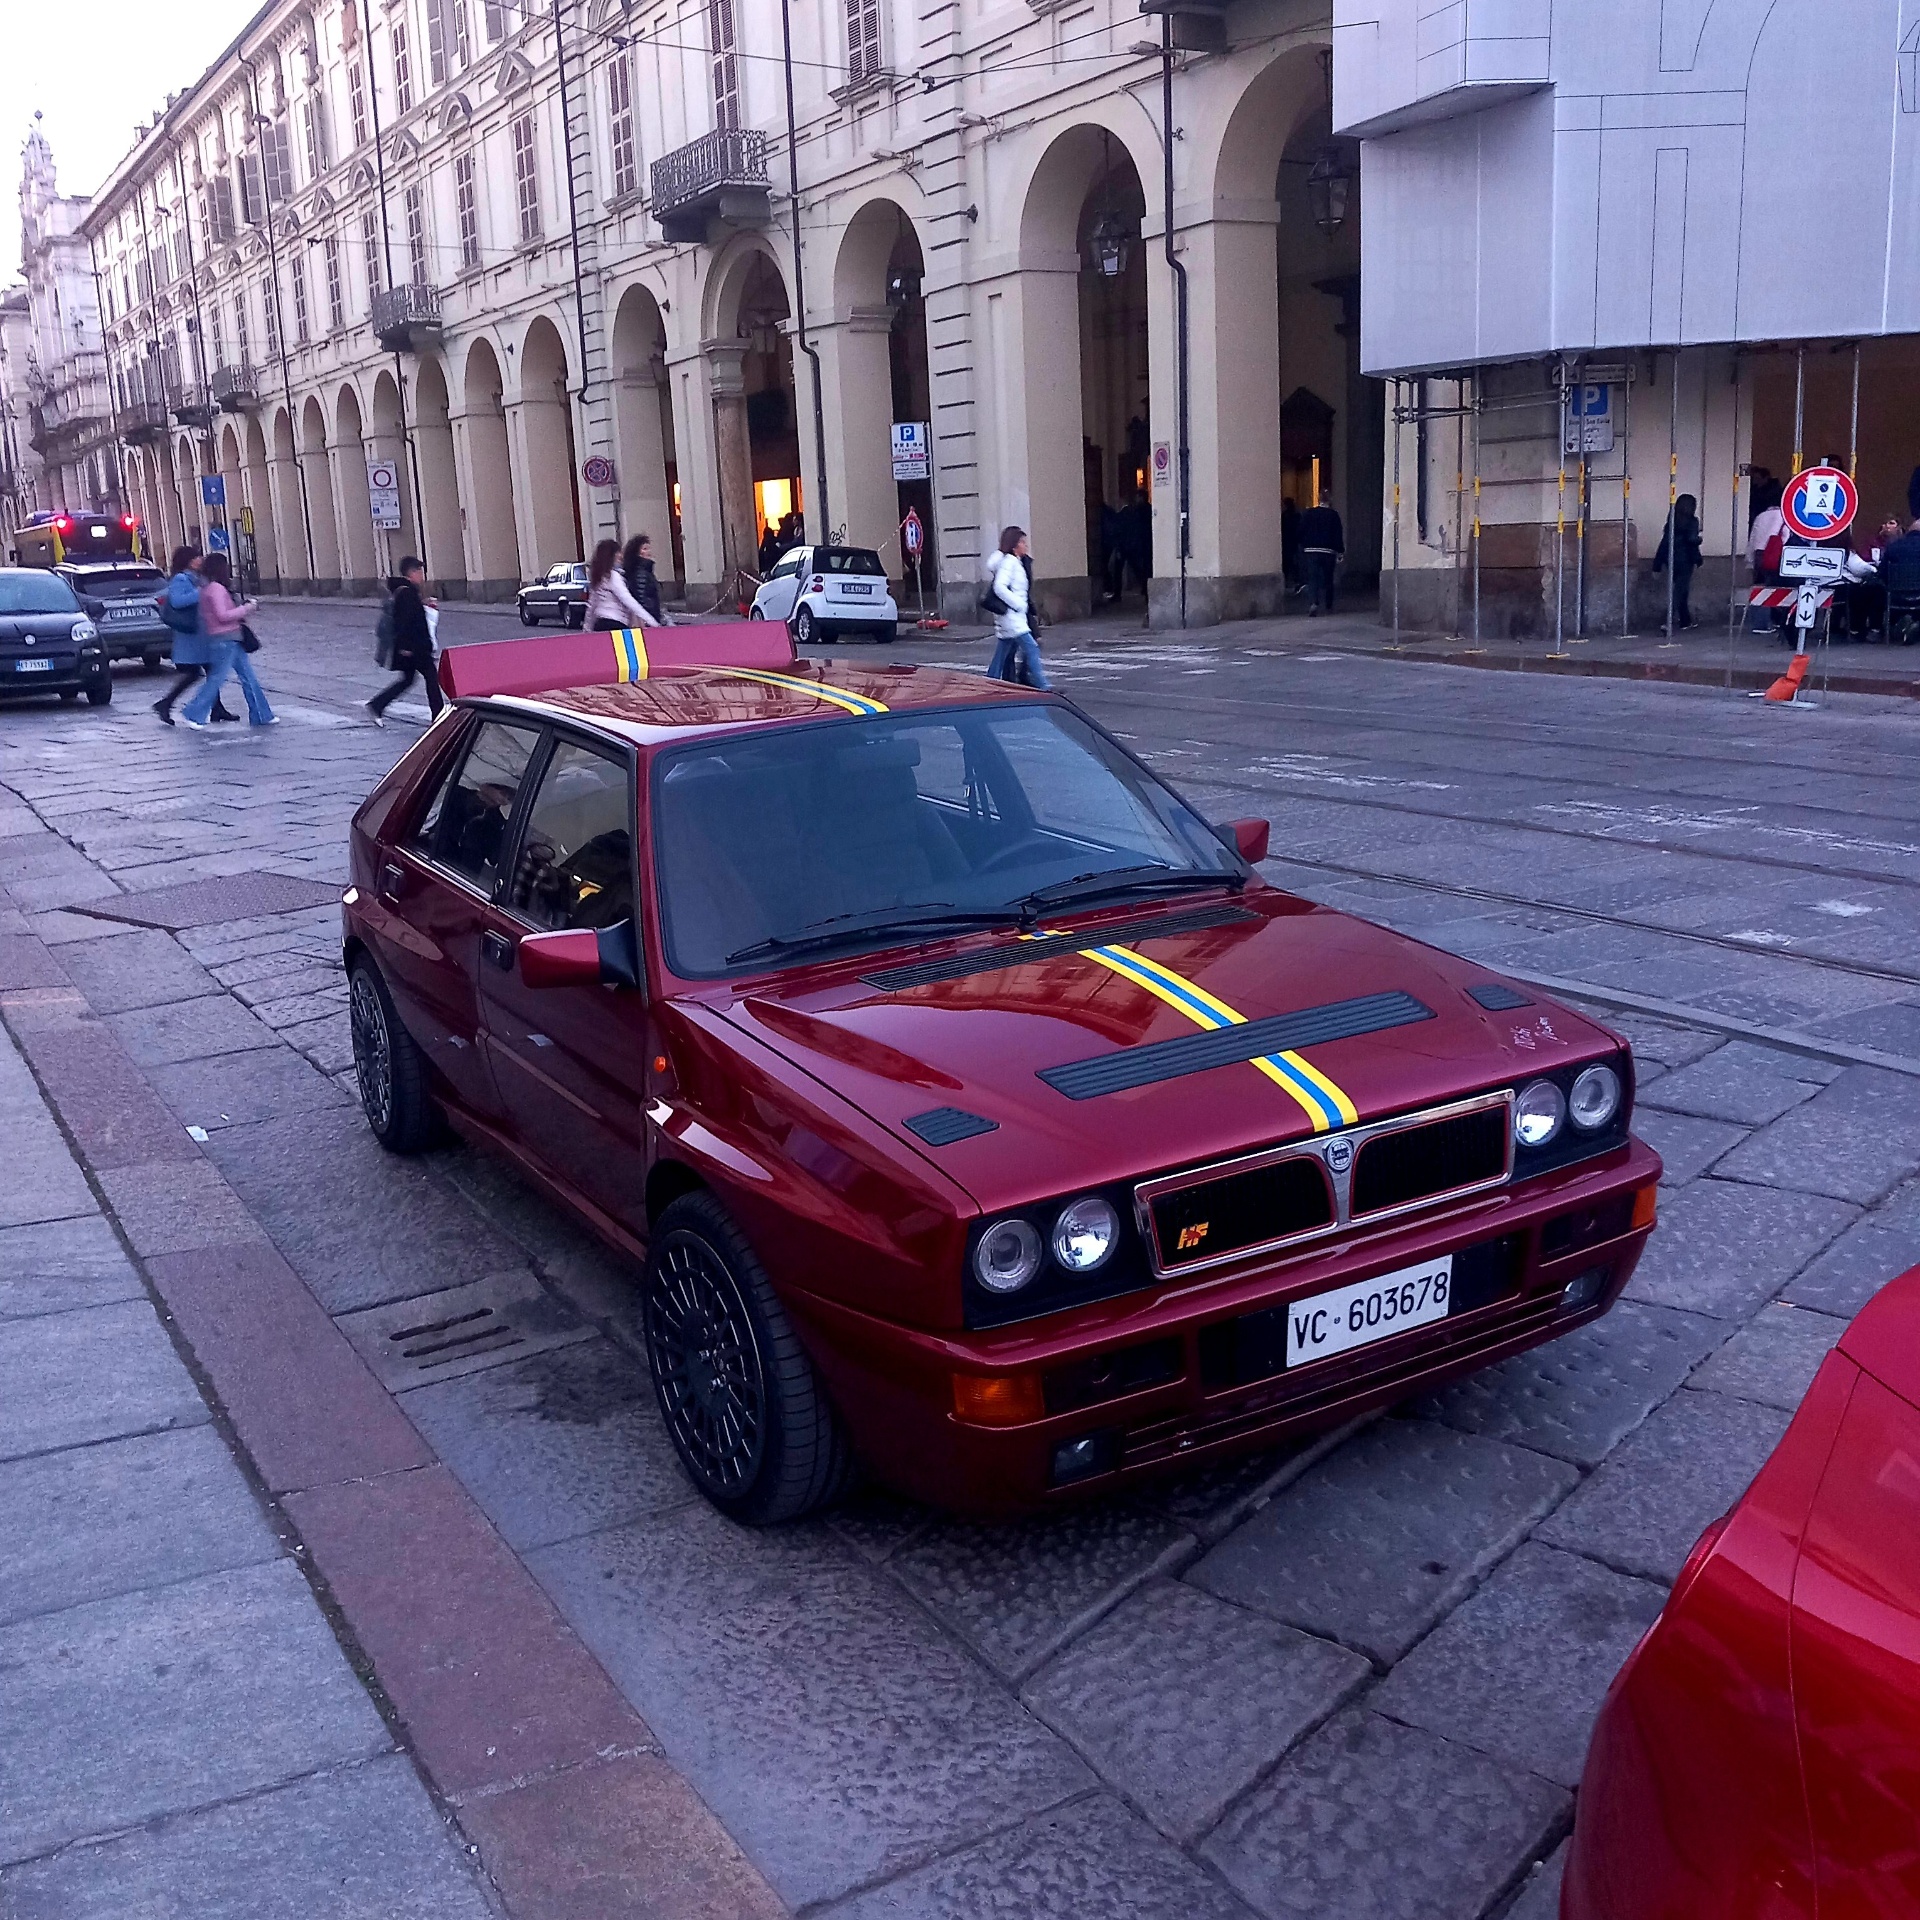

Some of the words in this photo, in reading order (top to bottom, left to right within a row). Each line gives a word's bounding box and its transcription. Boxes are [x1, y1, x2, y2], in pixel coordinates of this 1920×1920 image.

[903, 427, 913, 440] P
[1176, 1221, 1209, 1250] HF
[1349, 1271, 1449, 1332] 603678
